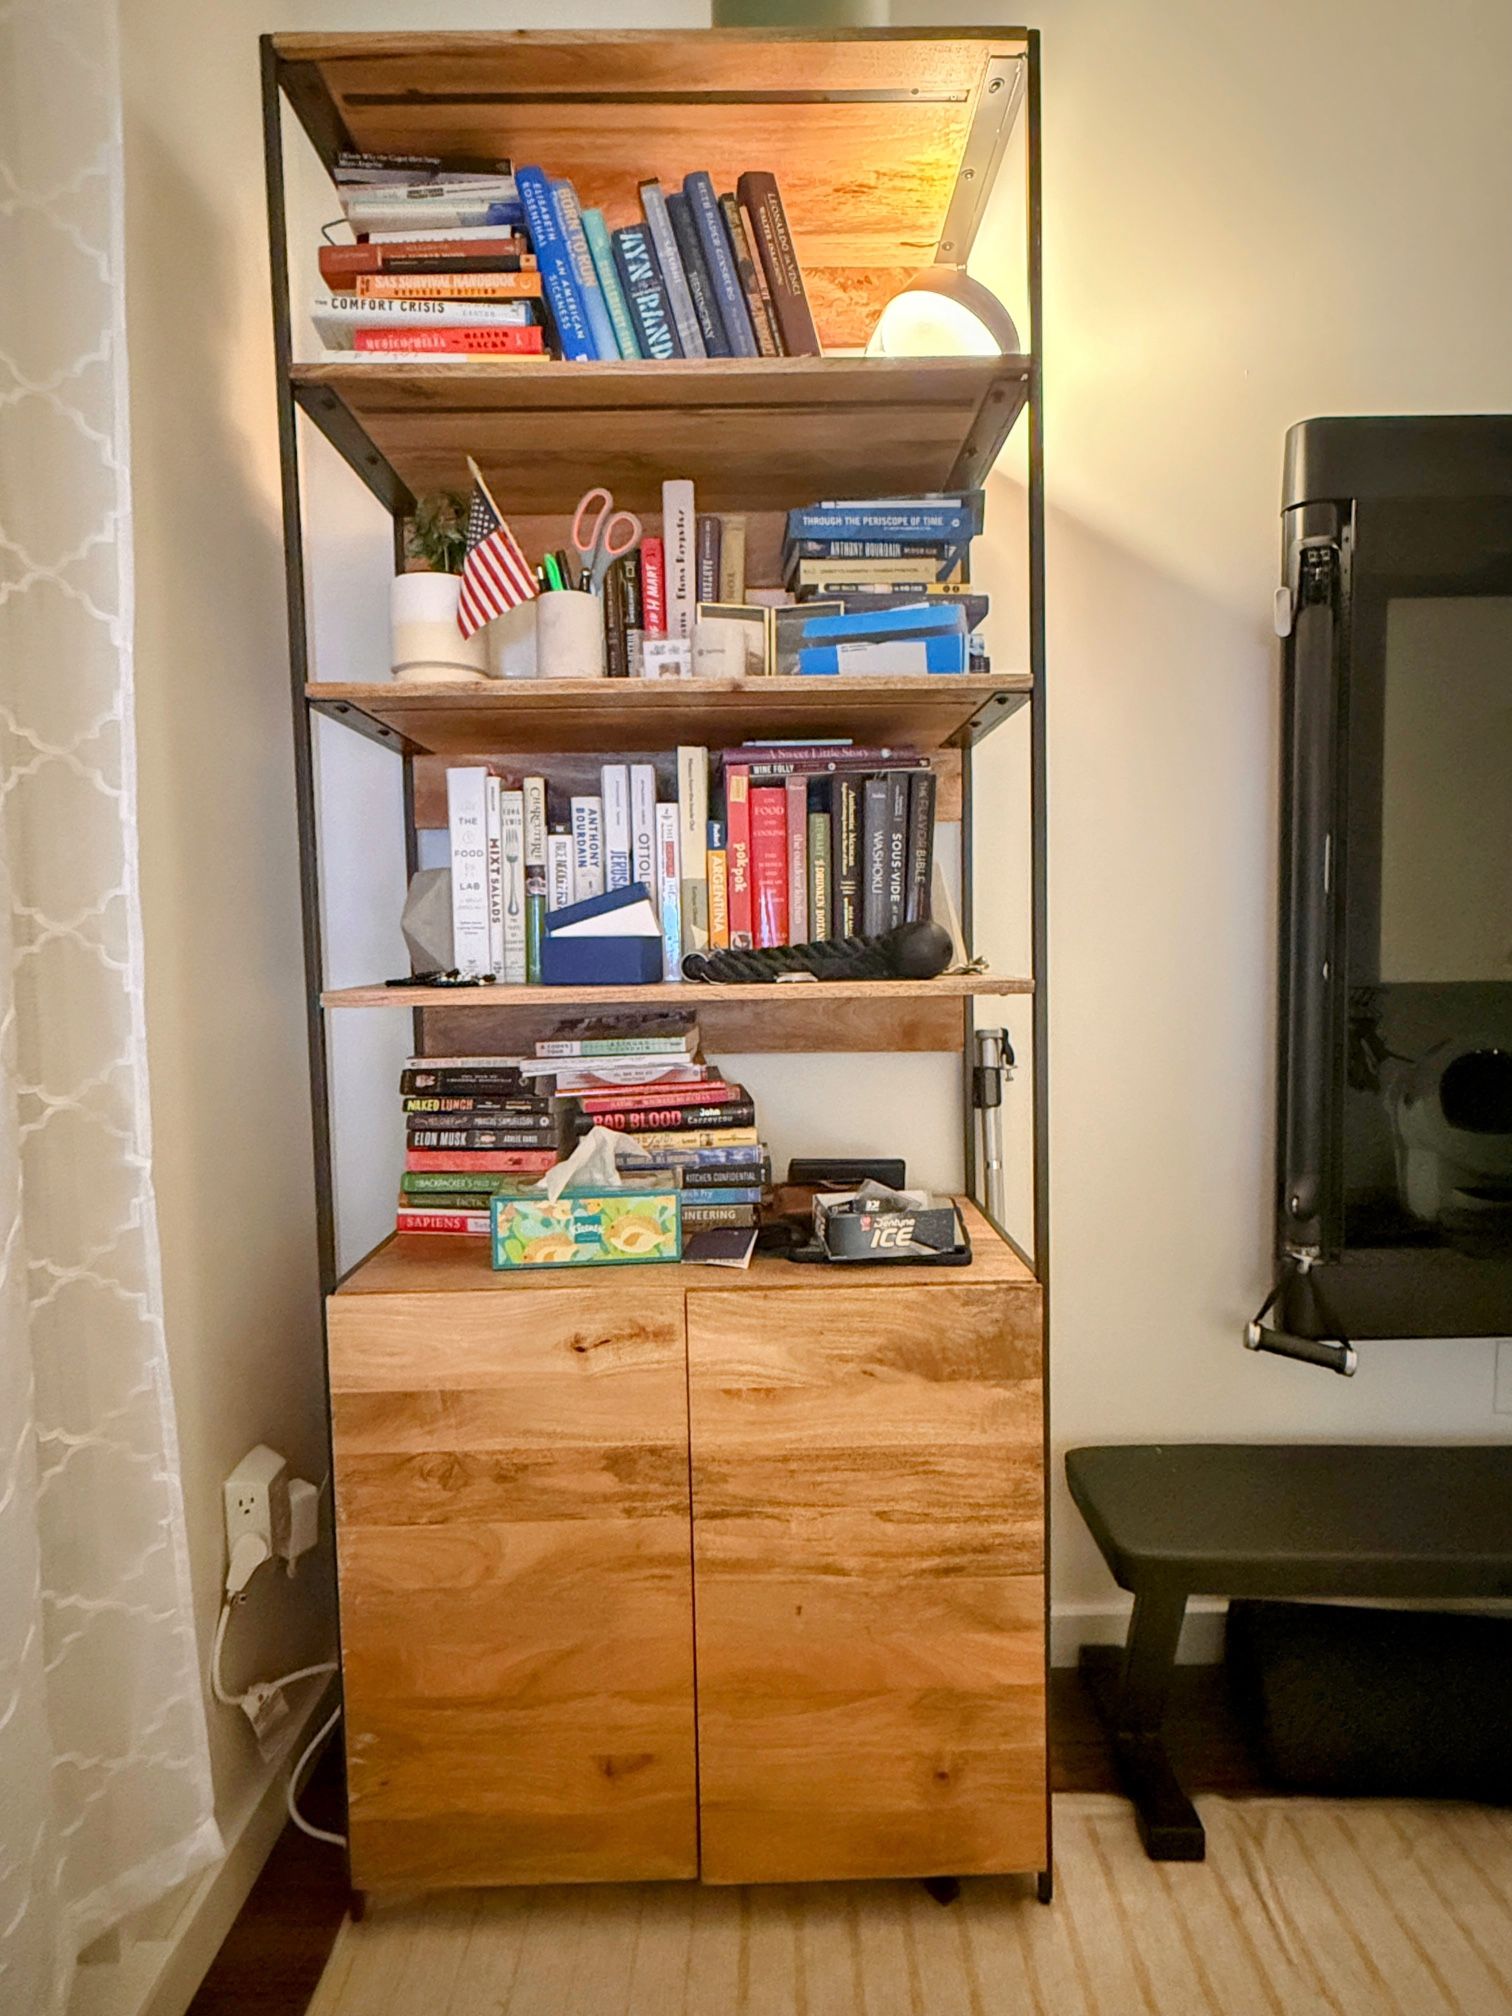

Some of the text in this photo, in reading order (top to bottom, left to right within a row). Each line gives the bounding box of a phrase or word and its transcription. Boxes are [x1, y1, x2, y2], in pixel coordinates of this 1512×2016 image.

[620, 233, 654, 282] AYN
[374, 274, 516, 288] SAS SURVIVAL HANDBOOK
[331, 298, 393, 312] COMFORT
[400, 301, 445, 314] CRISIS
[636, 292, 674, 360] RAND
[803, 516, 842, 526] THROUGH
[845, 516, 860, 526] THE
[863, 516, 908, 526] PERISCOPE
[910, 516, 921, 526] OF
[646, 562, 658, 597] MART
[646, 598, 660, 612] H
[753, 765, 794, 774] WINE FOLLY
[754, 806, 785, 815] FOOD
[575, 808, 587, 868] BOURDAIN
[588, 808, 600, 868] ANTHONY
[454, 850, 484, 858] FOOD
[872, 830, 884, 894] WASHOKU
[915, 850, 926, 884] BIBLE
[610, 850, 628, 890] JERUSA
[460, 882, 480, 890] LAB
[490, 838, 500, 924] MIXT SALADS
[712, 856, 724, 933] ARGENTINA
[406, 1099, 474, 1111] NAKED LUNCH
[700, 1108, 720, 1116] John
[592, 1110, 682, 1130] BAD BLOOD
[688, 1116, 734, 1124] Carreyrou
[414, 1132, 468, 1146] ELON MUSK
[685, 1172, 756, 1183] KITCHEN CONFIDENTIAL
[406, 1216, 461, 1229] SAPIENS
[874, 1218, 916, 1228] Dentyne
[870, 1226, 915, 1248] ICE
